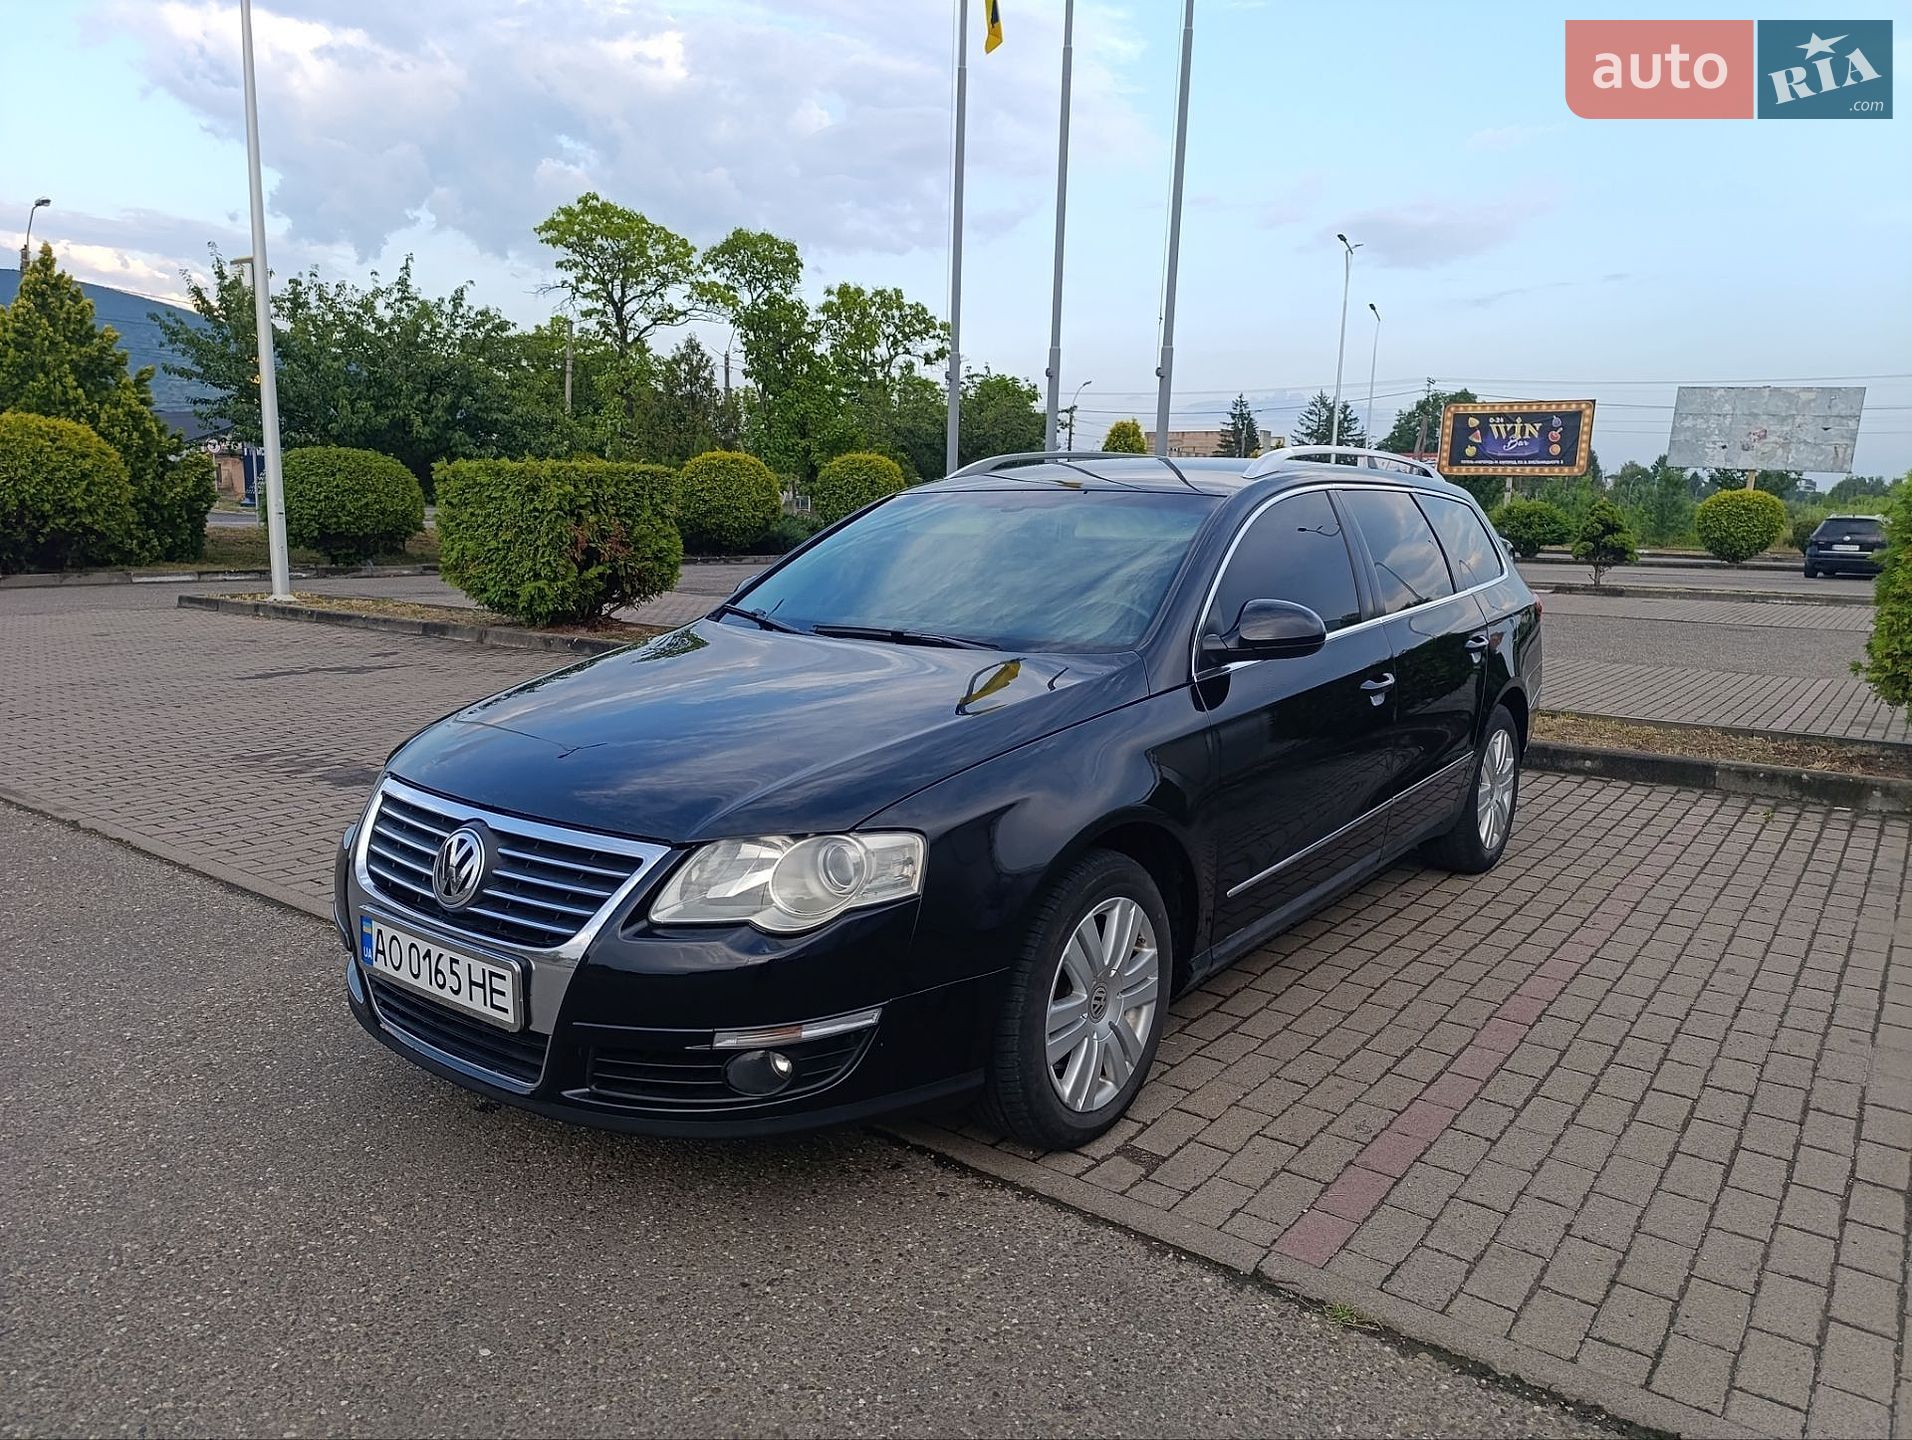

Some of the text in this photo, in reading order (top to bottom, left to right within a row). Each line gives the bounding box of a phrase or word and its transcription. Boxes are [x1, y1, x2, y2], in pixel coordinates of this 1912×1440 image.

[1503, 435, 1529, 451] Bar
[363, 947, 373, 960] UA
[374, 928, 509, 1014] AO 0165 HE
